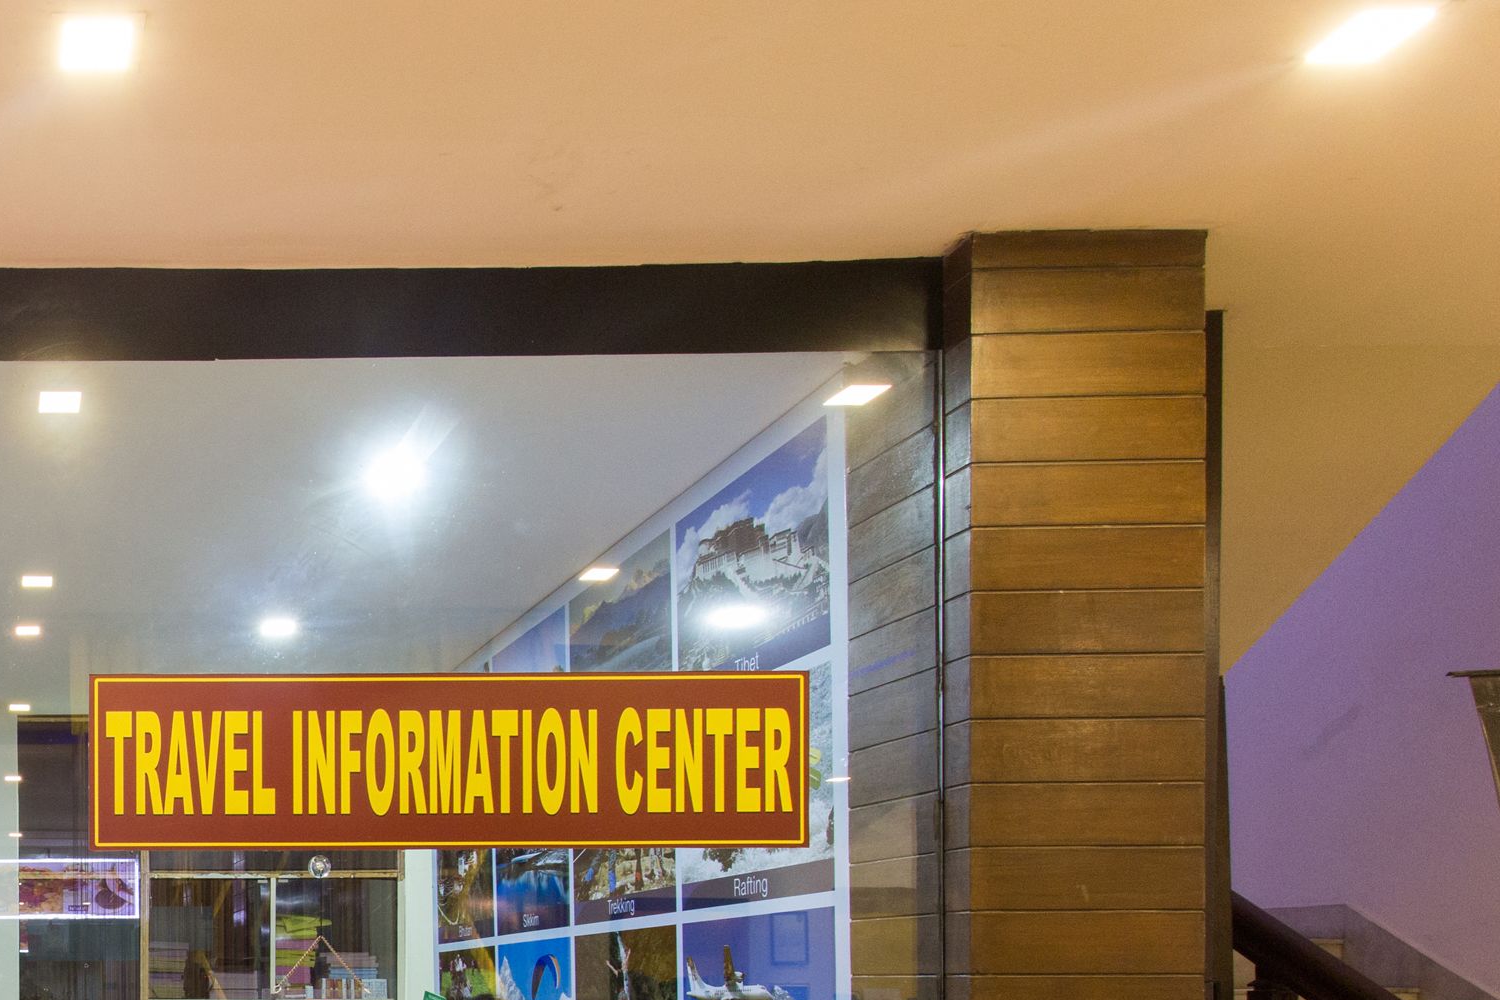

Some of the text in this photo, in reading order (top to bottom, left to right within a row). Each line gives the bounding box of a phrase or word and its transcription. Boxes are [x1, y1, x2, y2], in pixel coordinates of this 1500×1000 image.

[105, 707, 793, 816] TRAVEL INFORMATION CENTER
[734, 876, 768, 897] Rafting
[607, 899, 635, 916] Trekking
